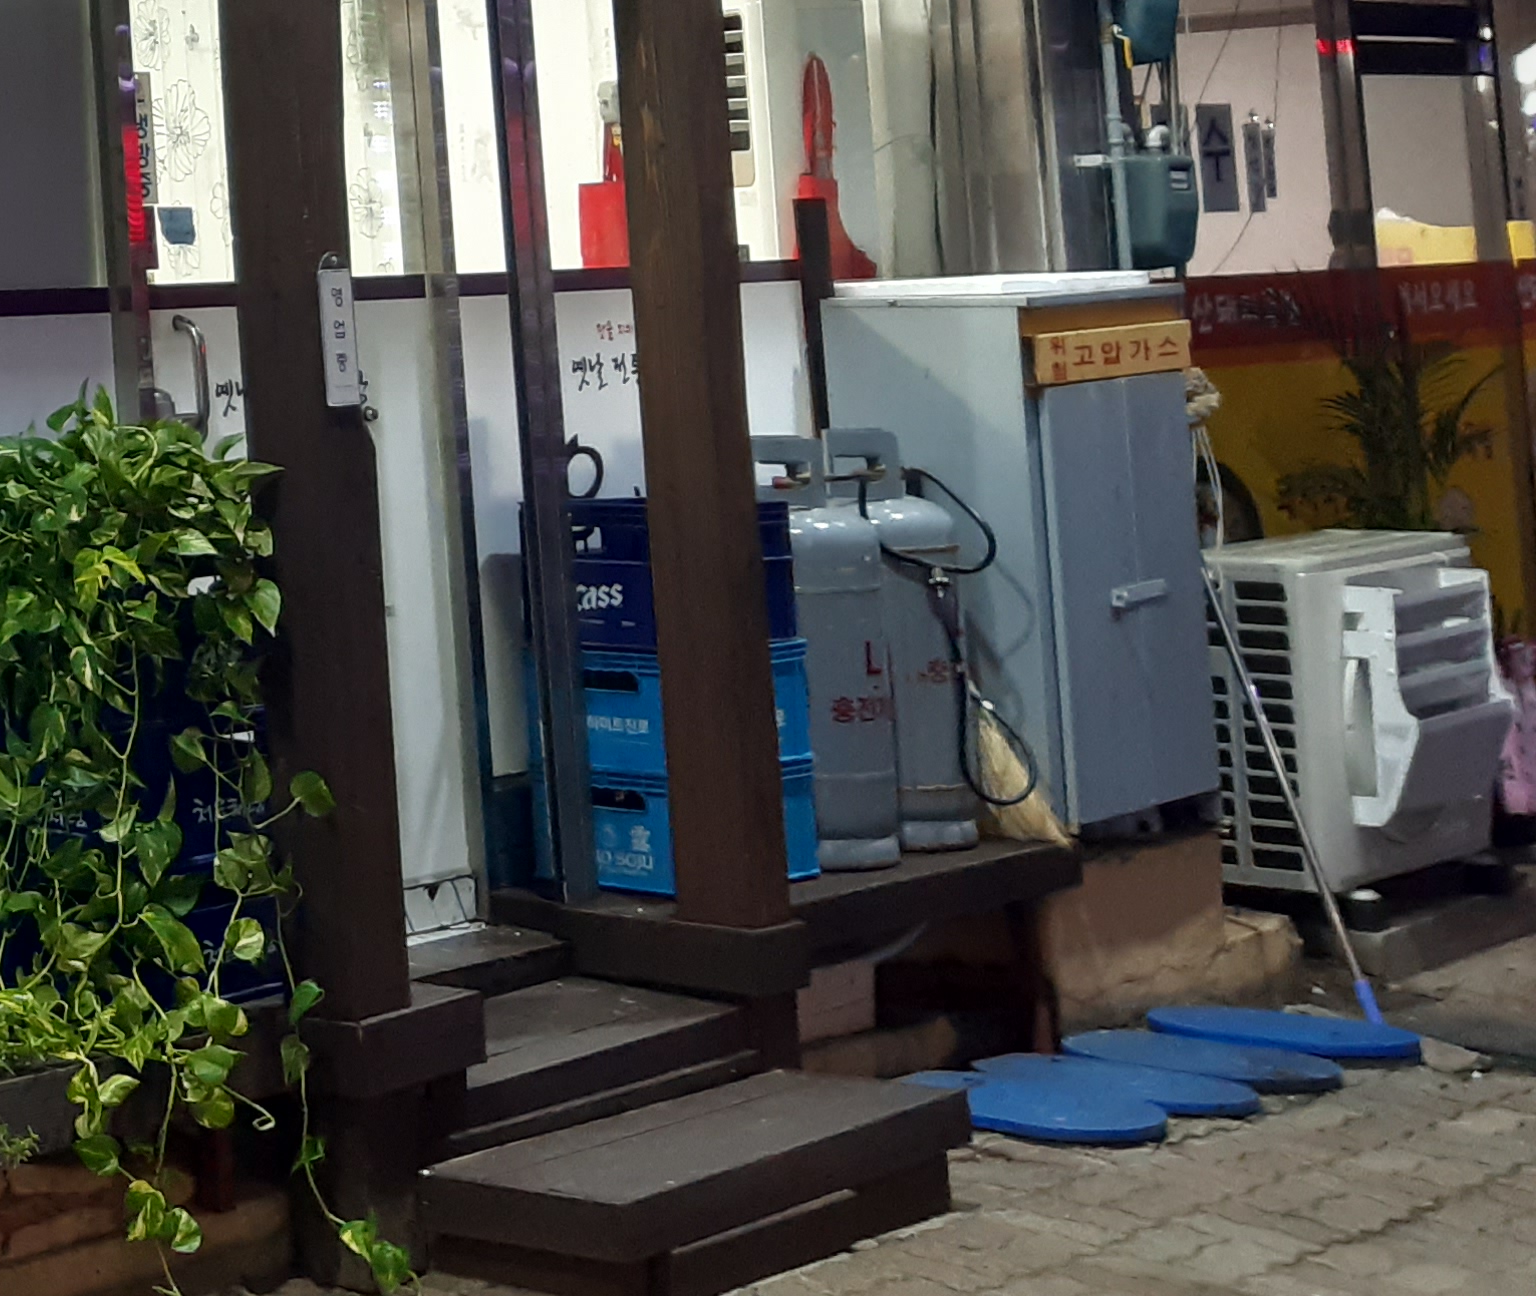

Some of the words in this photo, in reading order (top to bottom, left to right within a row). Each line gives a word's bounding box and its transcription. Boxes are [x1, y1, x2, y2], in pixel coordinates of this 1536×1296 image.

[330, 287, 348, 373] 영업중
[1072, 337, 1179, 366] 고압가스
[571, 352, 609, 392] 옛날
